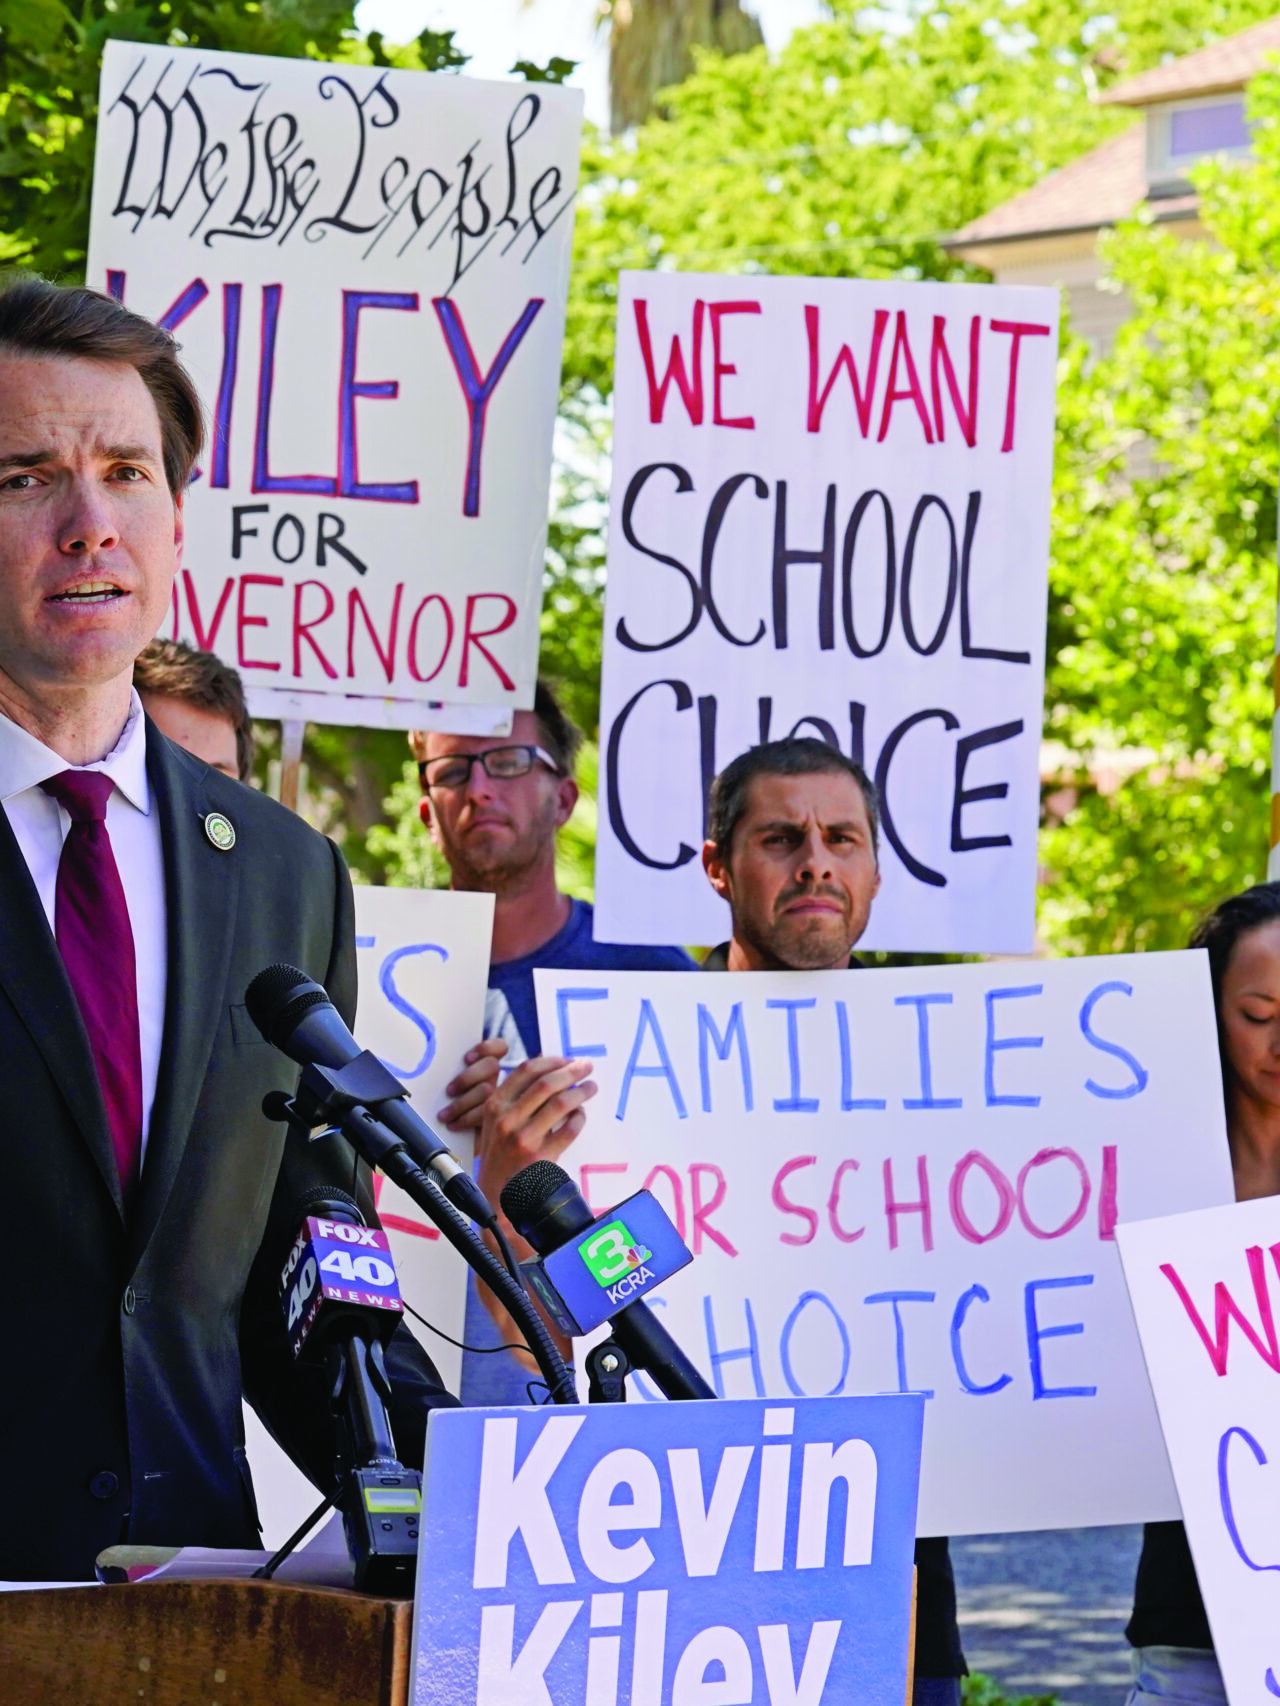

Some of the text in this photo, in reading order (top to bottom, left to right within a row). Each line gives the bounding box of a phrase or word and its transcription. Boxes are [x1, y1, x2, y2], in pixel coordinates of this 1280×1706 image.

[107, 57, 577, 298] We the People
[633, 299, 1051, 453] WE WANT
[232, 503, 368, 576] FOR
[616, 463, 1031, 664] SCHOOL
[556, 980, 1149, 1121] FAMILIES
[280, 1229, 308, 1290] FOX
[317, 1219, 381, 1249] FOX
[320, 1250, 396, 1287] 40
[587, 1229, 634, 1279] 3
[288, 1256, 318, 1332] 40
[328, 1287, 401, 1309] NEWS
[606, 1266, 656, 1305] KCRA
[631, 1274, 1098, 1402] HOICE
[473, 1407, 878, 1590] Kevin
[477, 1589, 842, 1706] Kiley
